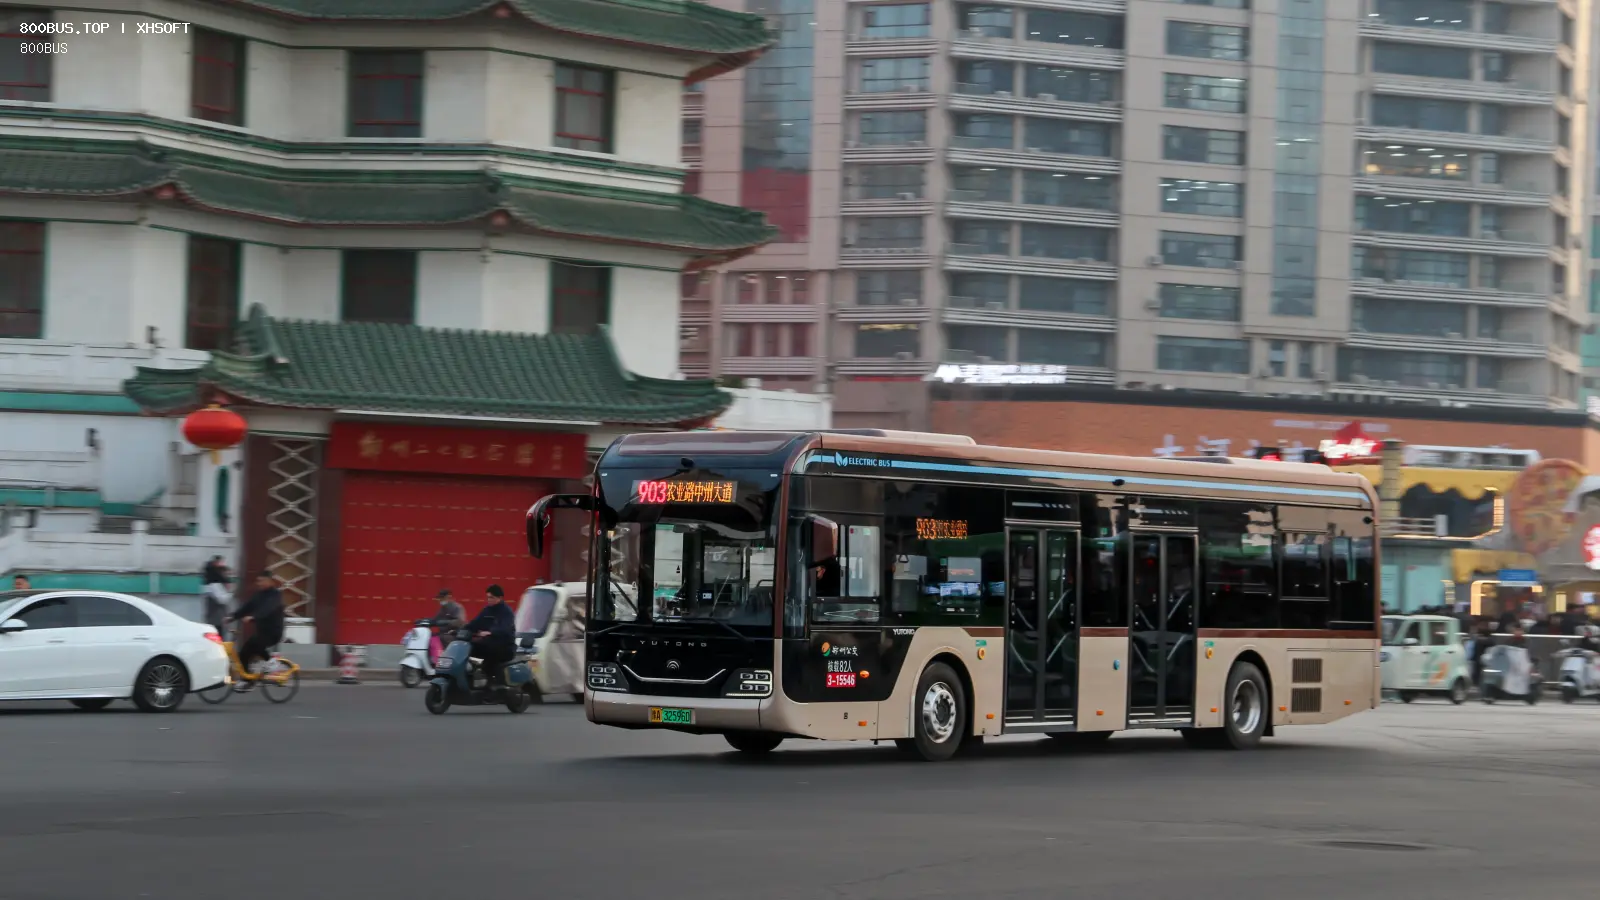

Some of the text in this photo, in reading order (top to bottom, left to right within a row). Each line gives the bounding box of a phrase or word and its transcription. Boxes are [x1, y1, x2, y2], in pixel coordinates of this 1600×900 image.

[848, 457, 891, 467] ELECTRIC BUS
[637, 480, 733, 503] 903 农业路中州大道
[916, 518, 936, 540] 903
[892, 628, 916, 636] YUTONG
[639, 639, 708, 648] YUTONG
[827, 660, 853, 673] 核载82人
[827, 674, 856, 686] 3-15546
